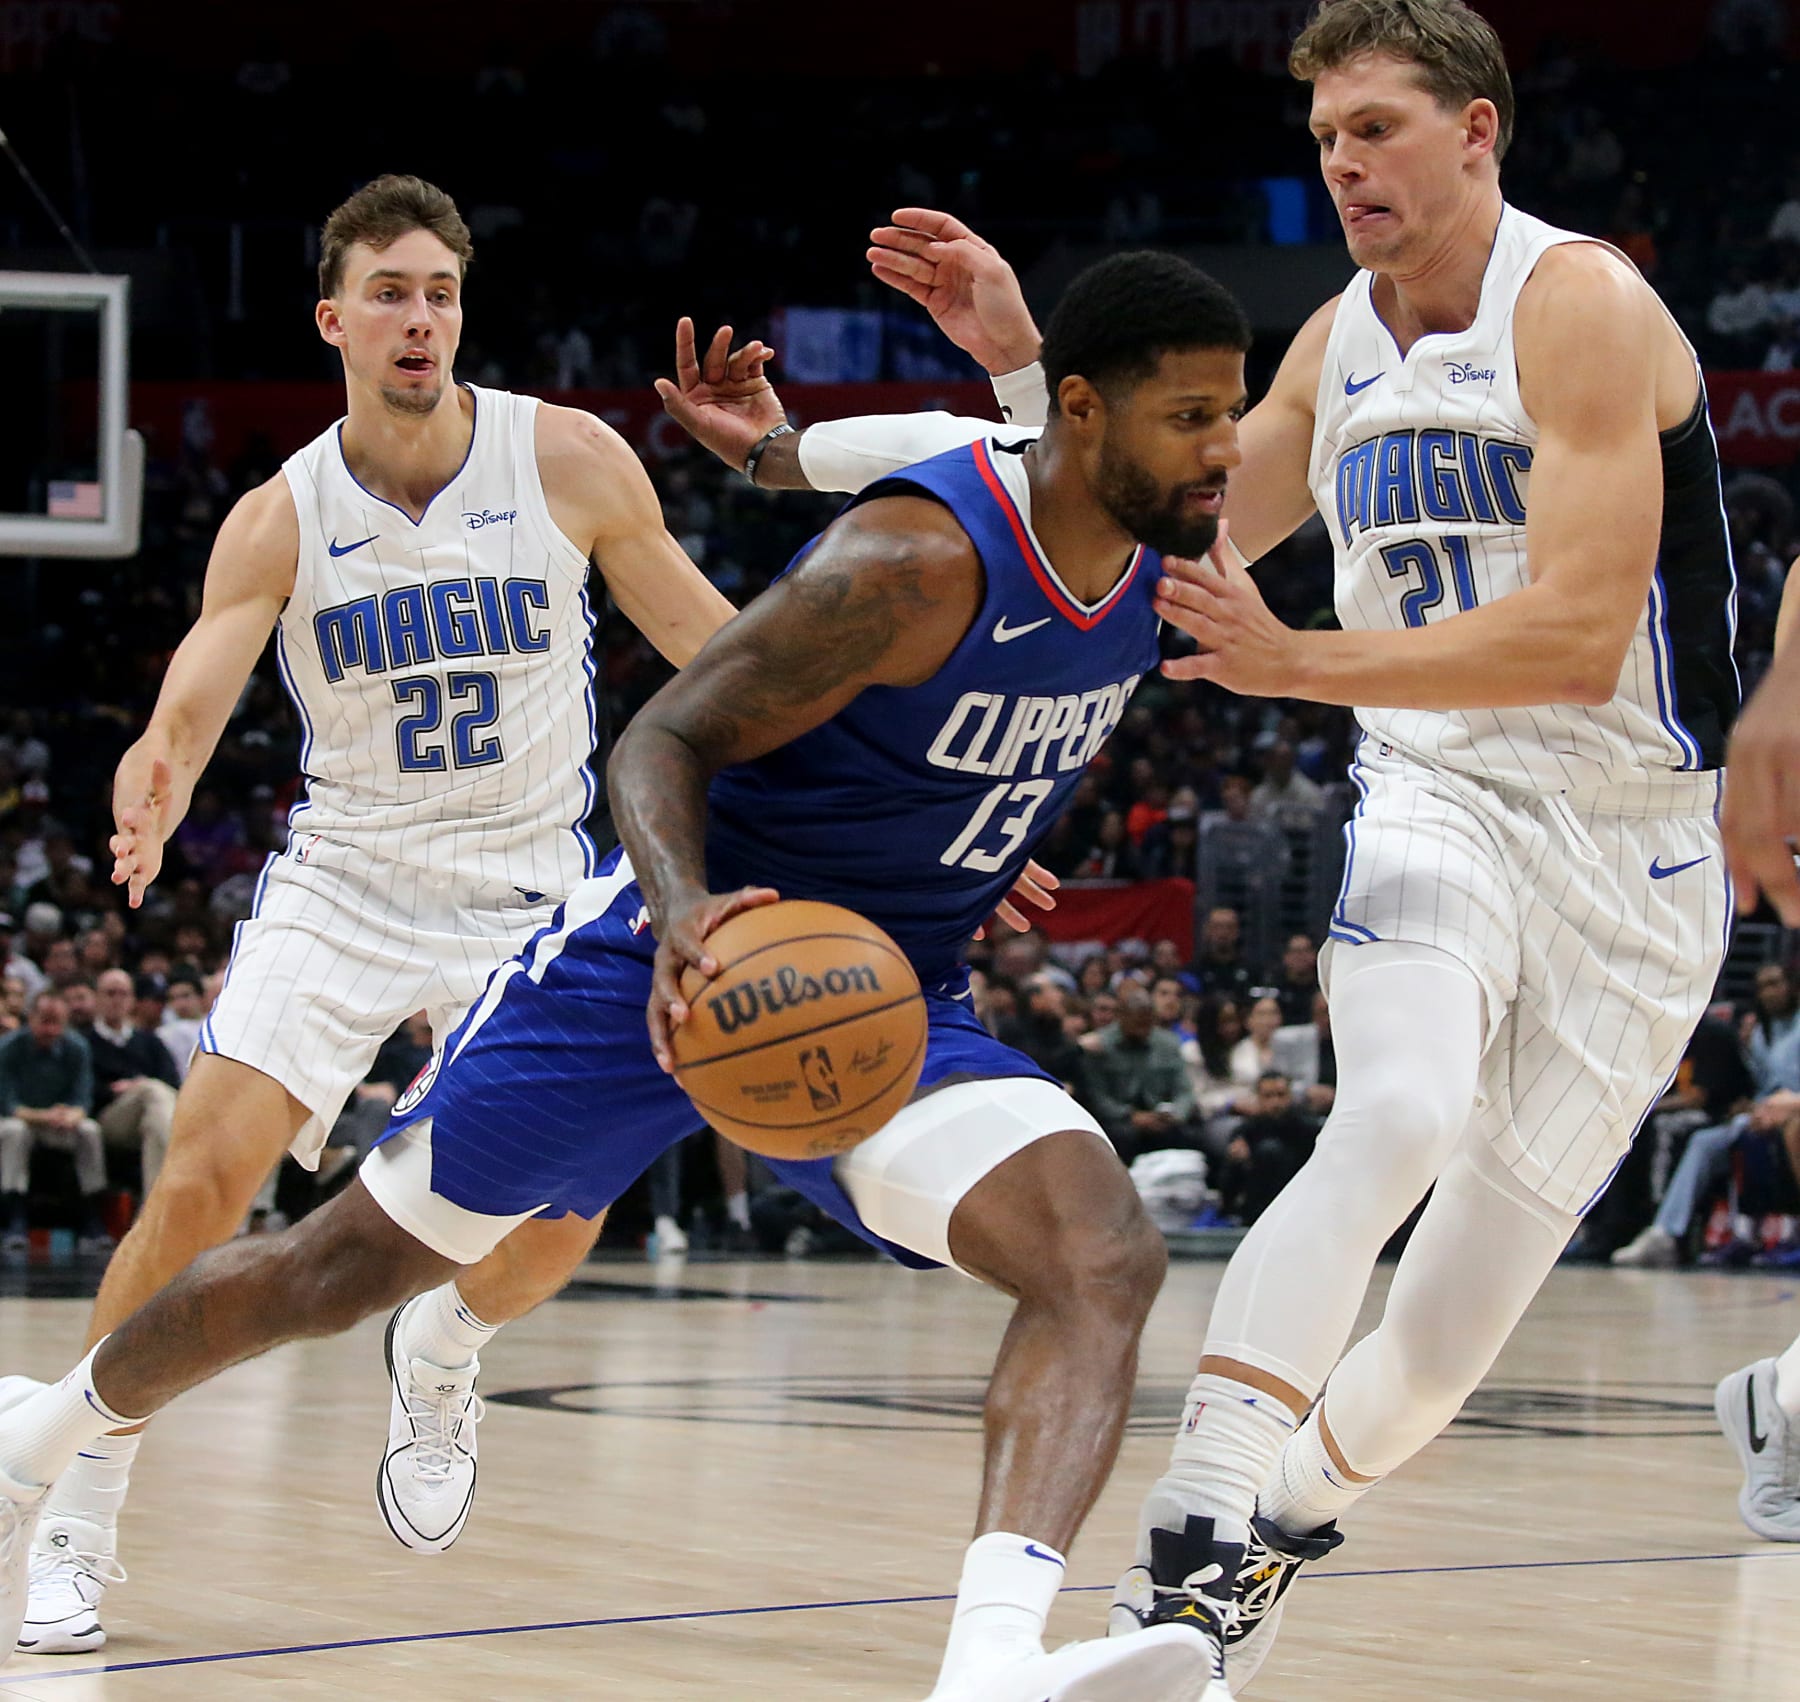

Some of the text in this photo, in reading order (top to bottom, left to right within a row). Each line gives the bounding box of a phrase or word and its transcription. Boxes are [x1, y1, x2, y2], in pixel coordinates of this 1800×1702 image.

[1336, 428, 1535, 550] MAGIC
[313, 577, 550, 684] MAGIC
[1379, 535, 1479, 629] 21
[391, 671, 504, 773] 22
[940, 778, 1055, 872] 13
[708, 964, 883, 1034] Wilson
